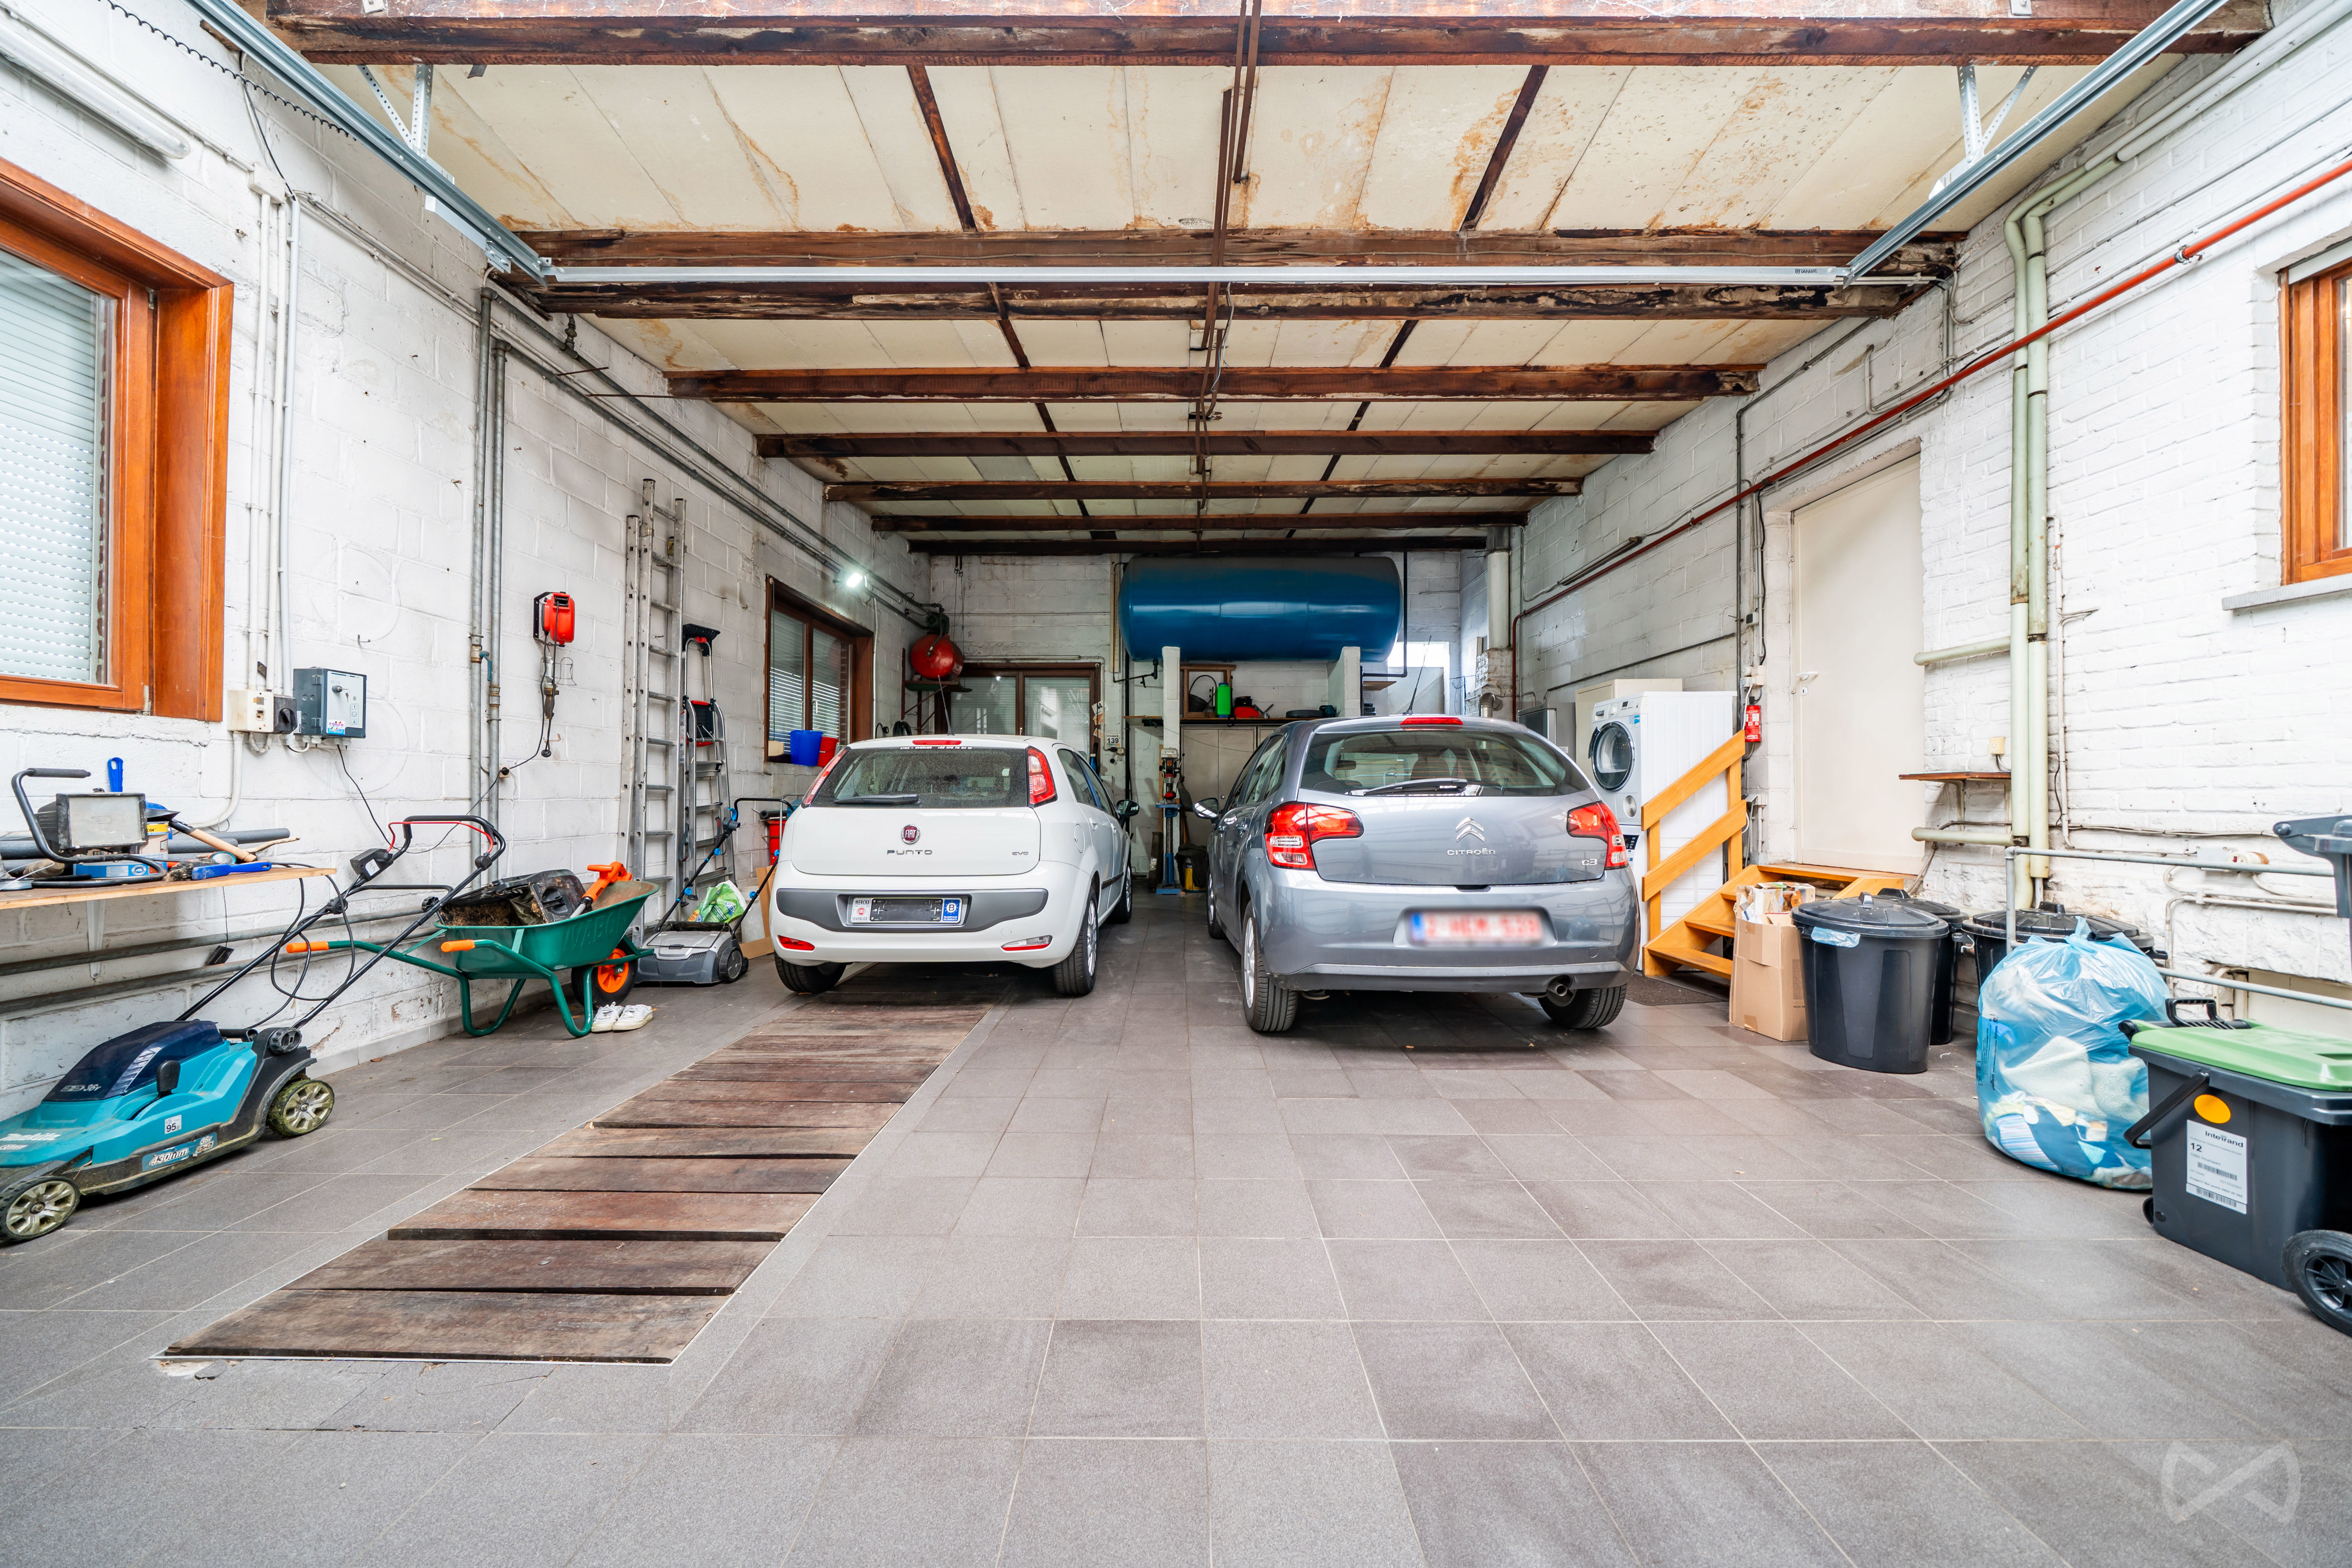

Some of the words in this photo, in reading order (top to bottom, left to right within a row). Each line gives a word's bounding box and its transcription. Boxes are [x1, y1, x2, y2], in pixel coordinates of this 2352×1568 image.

[905, 829, 916, 838] FIAT
[166, 1123, 176, 1132] 95
[2190, 1143, 2202, 1152] 12
[149, 1148, 189, 1165] 430mm
